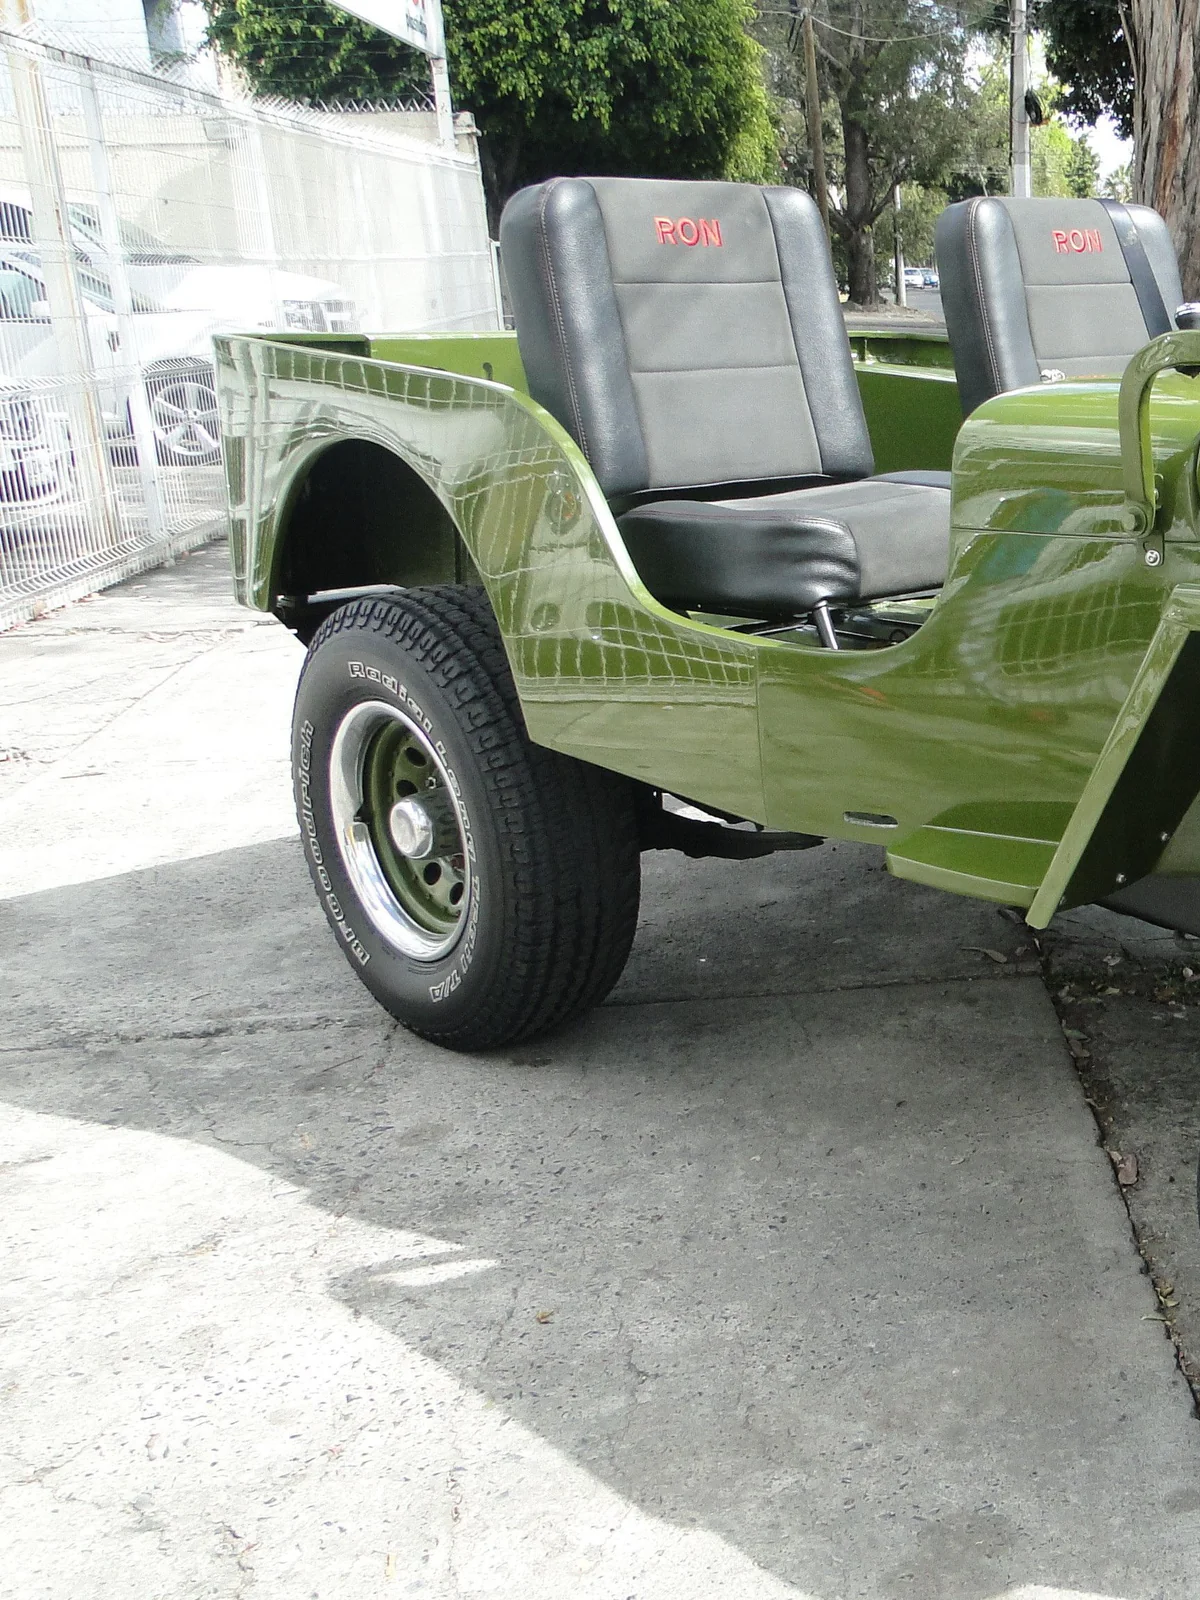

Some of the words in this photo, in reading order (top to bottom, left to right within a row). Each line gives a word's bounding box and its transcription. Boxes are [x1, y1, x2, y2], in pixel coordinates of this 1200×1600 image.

[654, 216, 723, 247] RON
[1052, 229, 1103, 253] RON
[348, 661, 433, 733] Radial
[436, 740, 476, 863] Long
[299, 720, 370, 967] BFGoodrich
[461, 875, 481, 974] Trail
[430, 970, 462, 1003] T/A
